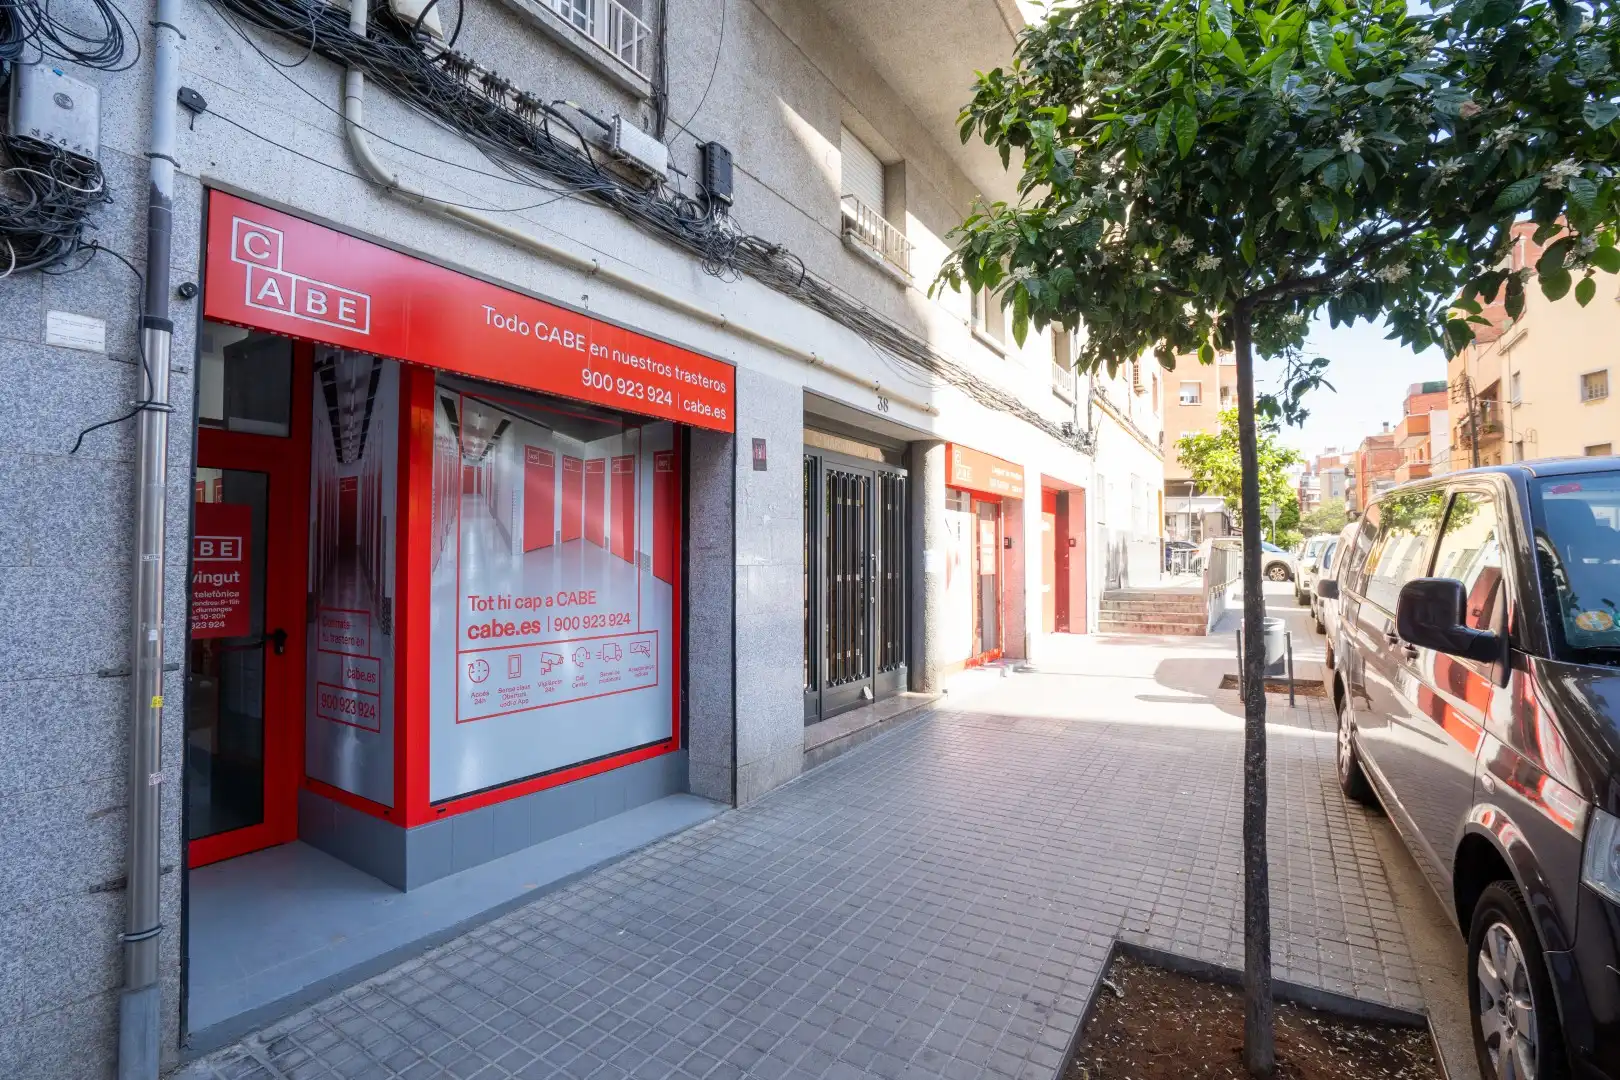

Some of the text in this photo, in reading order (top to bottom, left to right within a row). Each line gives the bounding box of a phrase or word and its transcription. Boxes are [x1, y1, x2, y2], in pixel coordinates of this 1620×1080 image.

[482, 304, 727, 394] Todo CABE en nuestros trasteros
[581, 368, 727, 420] 900 923 924 cabe.es
[877, 395, 889, 413] 38
[467, 590, 597, 612] Tot hi cap a CABE
[208, 620, 225, 628] 924
[467, 612, 631, 640] cabe.es 900 923 924
[347, 666, 376, 683] cabe.es
[321, 692, 376, 720] 900 923 924
